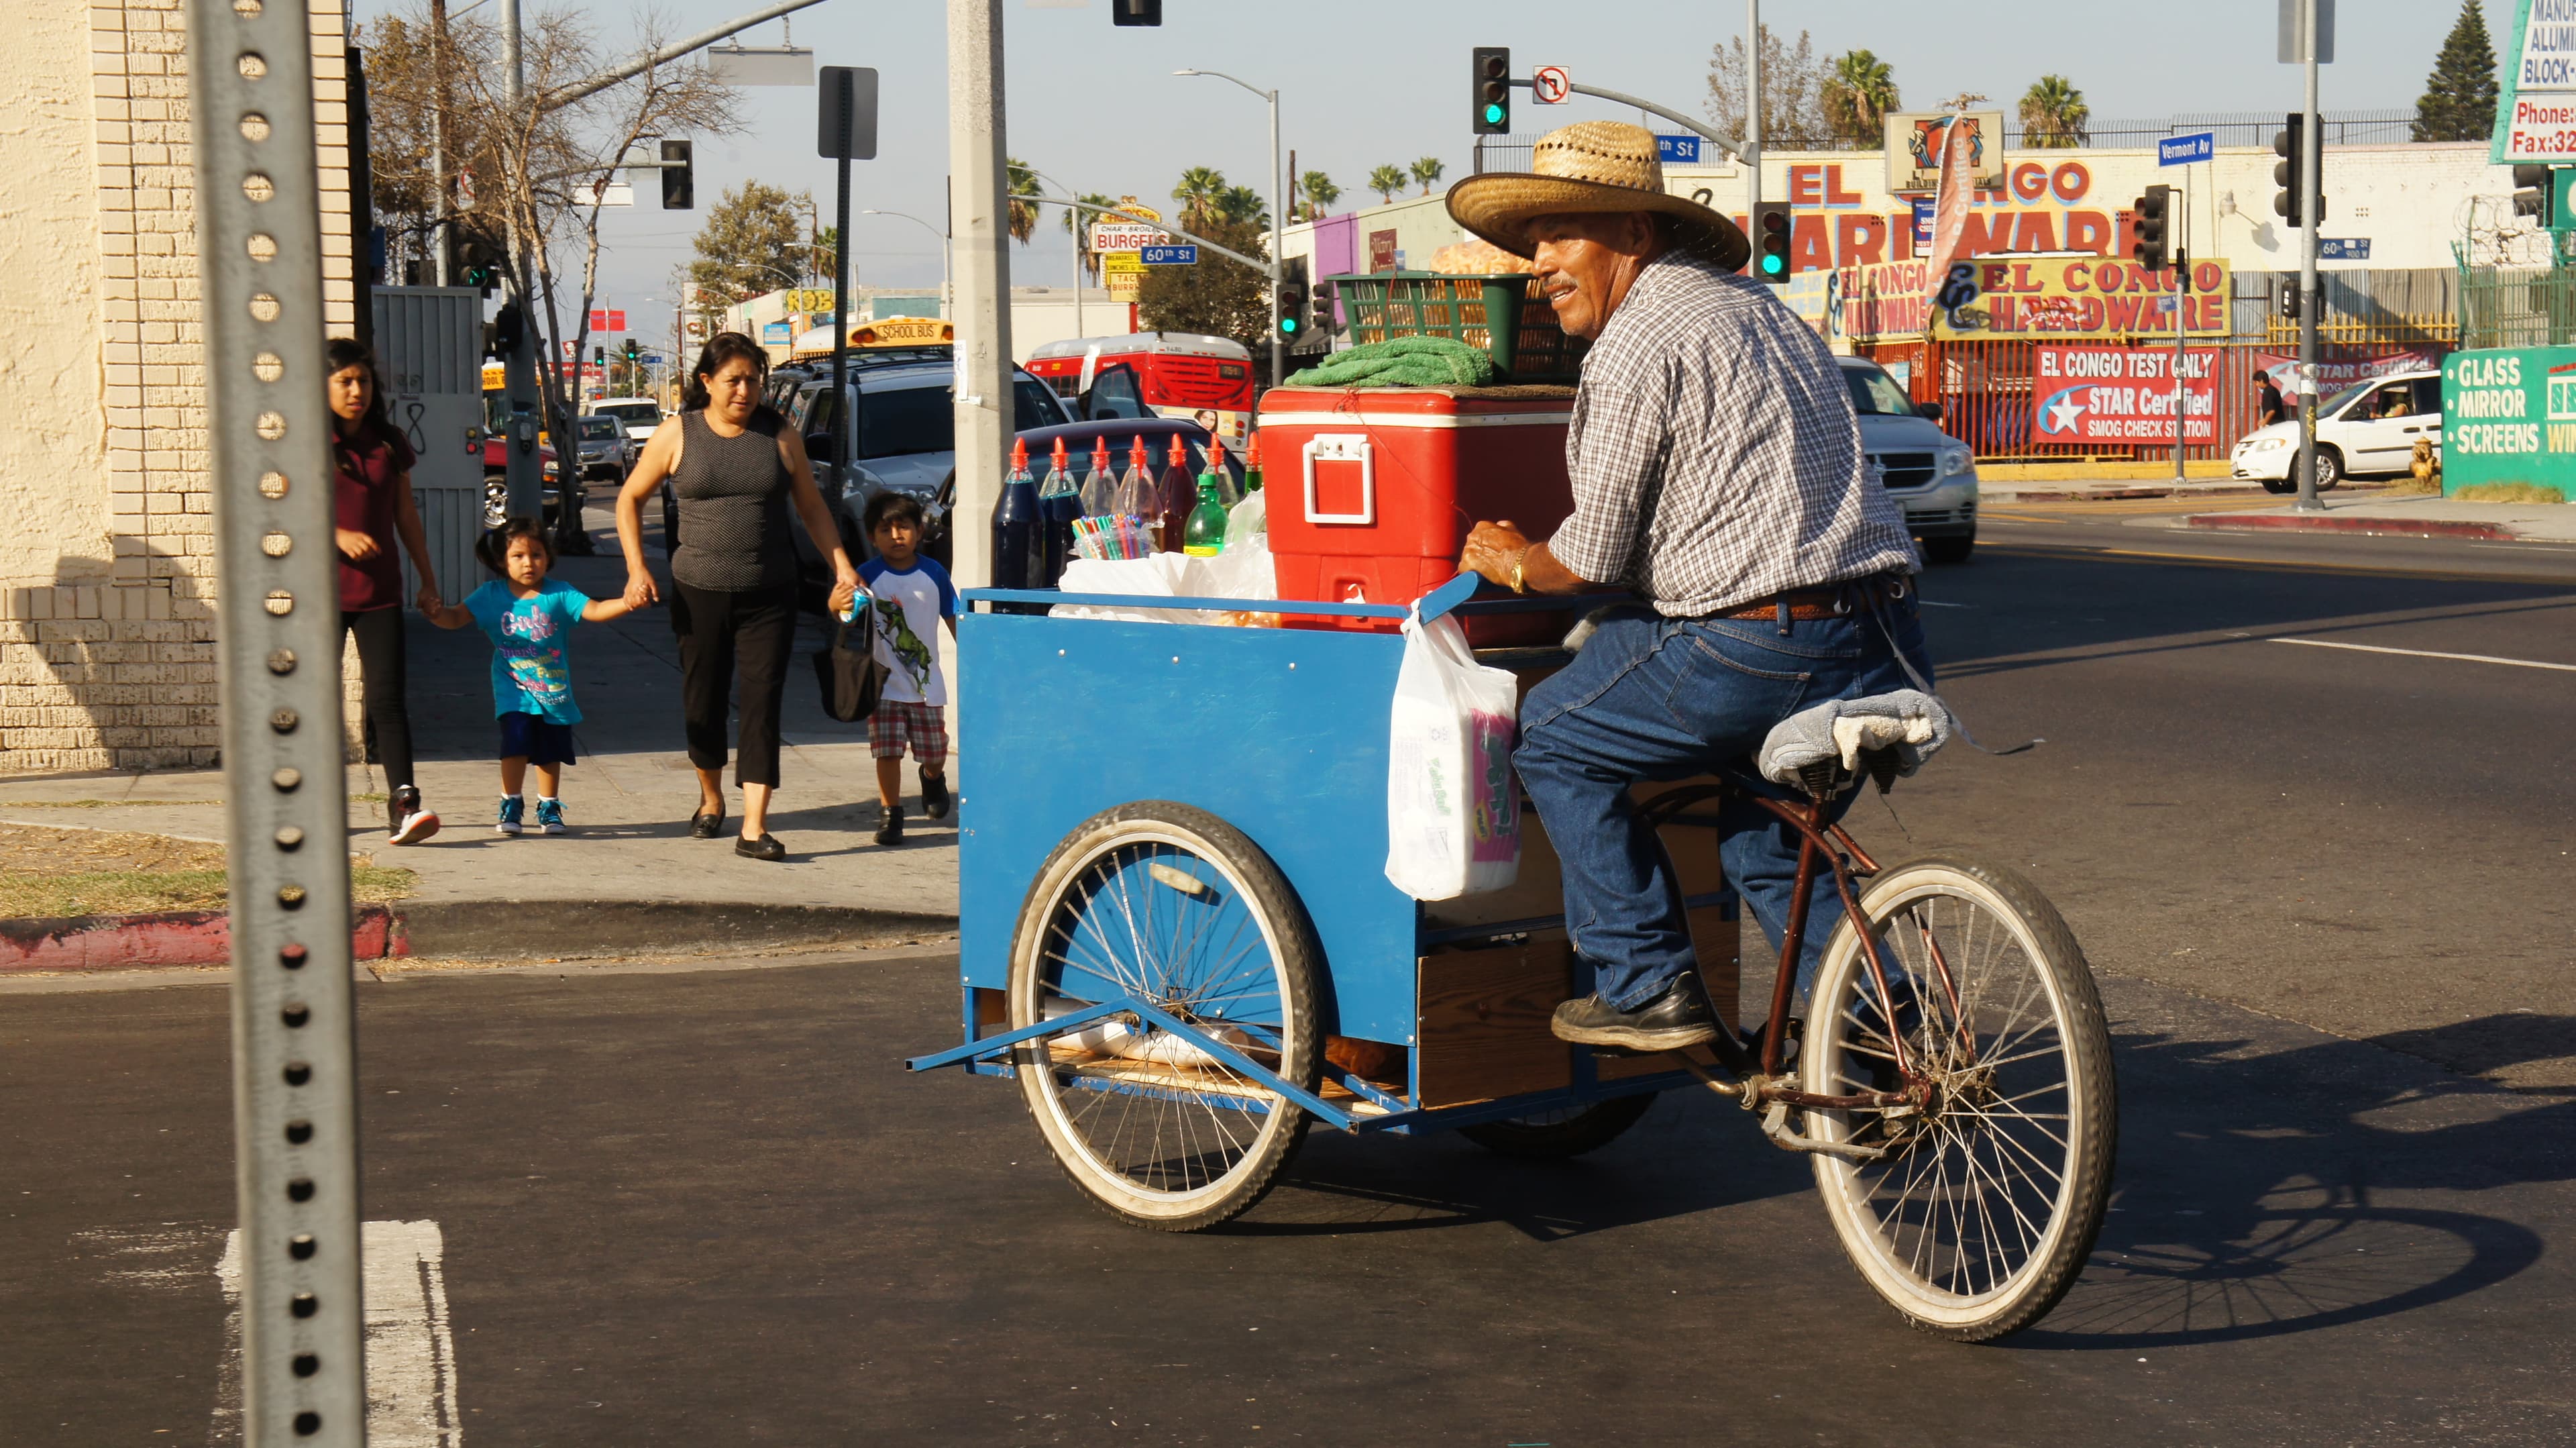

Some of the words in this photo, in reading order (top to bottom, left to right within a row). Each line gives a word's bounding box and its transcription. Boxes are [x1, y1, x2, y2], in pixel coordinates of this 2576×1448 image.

[2531, 28, 2576, 52] ALUMI
[1659, 137, 1672, 152] th
[1677, 141, 1695, 157] St
[2161, 142, 2196, 160] Vermont
[2199, 138, 2210, 154] Av
[1787, 164, 1862, 208] EL
[1906, 180, 1941, 189] BUILDIN
[1146, 249, 1174, 261] 60th
[1178, 250, 1191, 260] St
[1869, 263, 1927, 298] CONGO
[1981, 264, 2045, 293] EL
[1845, 295, 1929, 336] HARDWARE
[883, 326, 916, 339] SCHOOL
[918, 325, 934, 338] BUS
[2041, 352, 2061, 376] EL
[2065, 353, 2122, 377] CONGO
[2127, 354, 2167, 378] TEST
[2458, 357, 2521, 386] GLASS
[2089, 387, 2135, 415] STAR
[2139, 388, 2212, 415] Certfied
[2316, 383, 2342, 393] MOG
[2458, 389, 2526, 418] MIRROR
[2088, 420, 2121, 437] SMOG
[2124, 420, 2162, 437] CHECK
[2165, 421, 2211, 437] STTION
[2457, 423, 2539, 454] SCREENS
